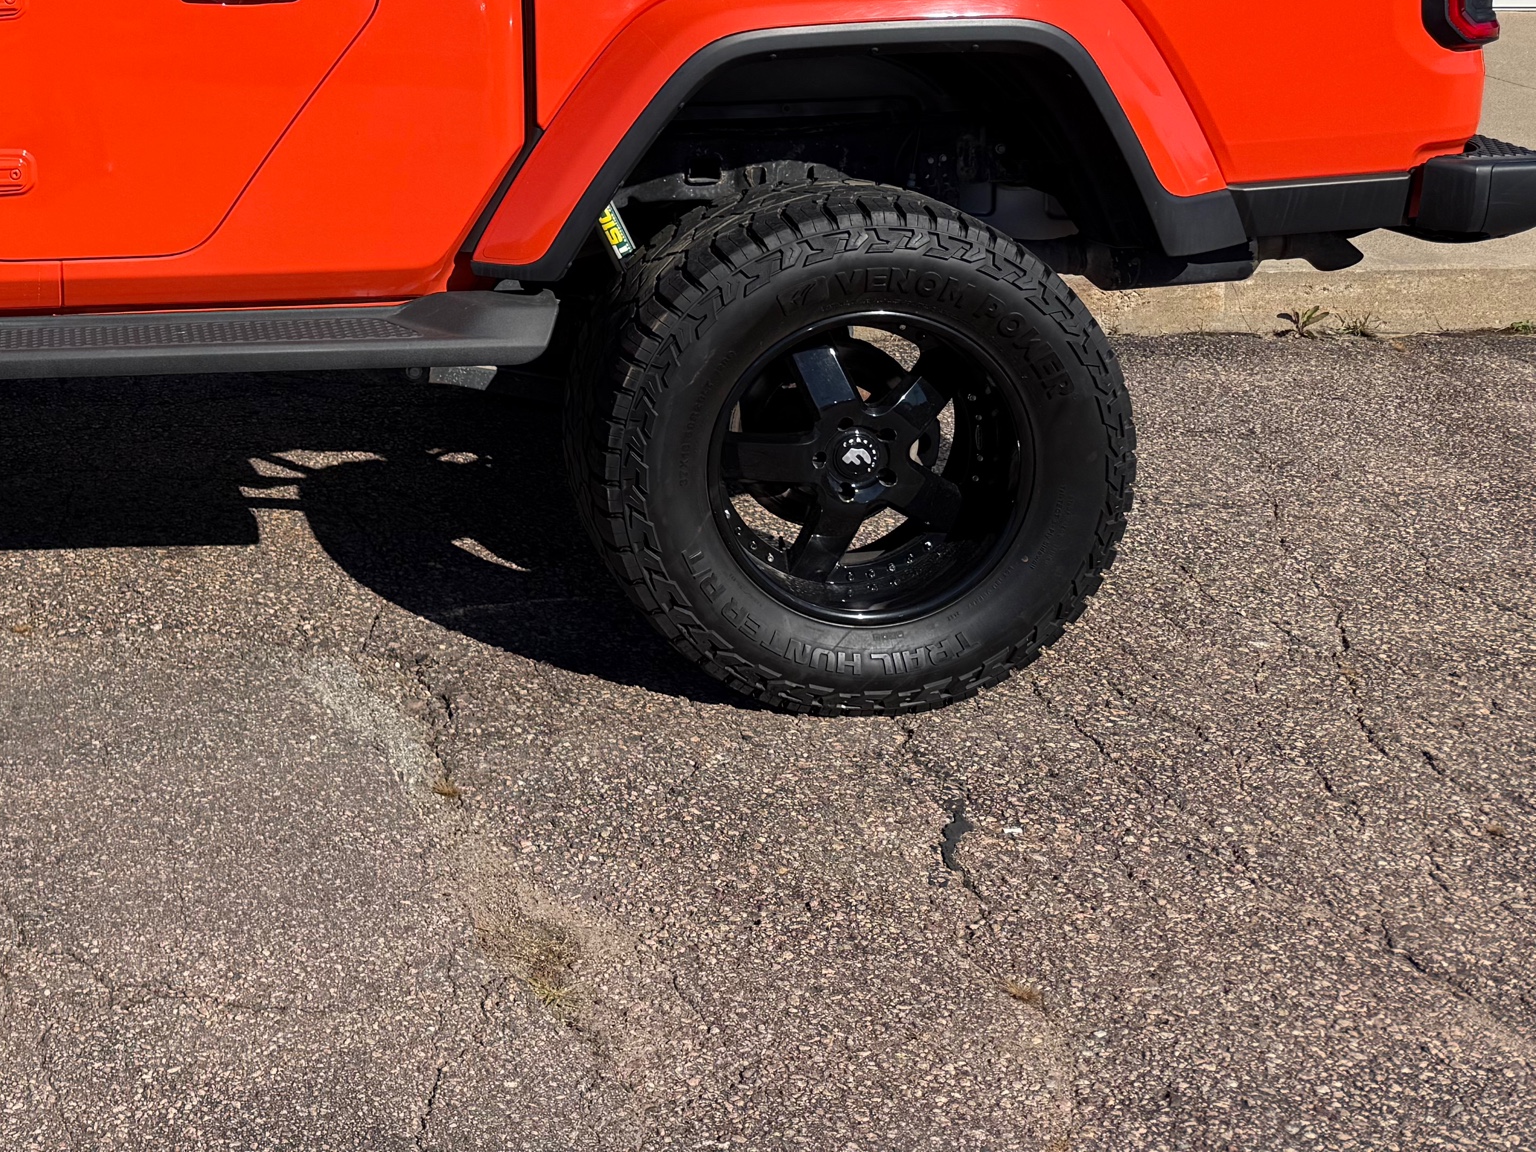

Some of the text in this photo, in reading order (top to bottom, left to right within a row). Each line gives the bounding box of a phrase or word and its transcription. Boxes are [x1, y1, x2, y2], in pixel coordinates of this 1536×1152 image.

[834, 265, 976, 311] VENOM
[972, 292, 1076, 402] POWER
[717, 595, 861, 676] HUNTER
[869, 627, 979, 677] TRAIL
